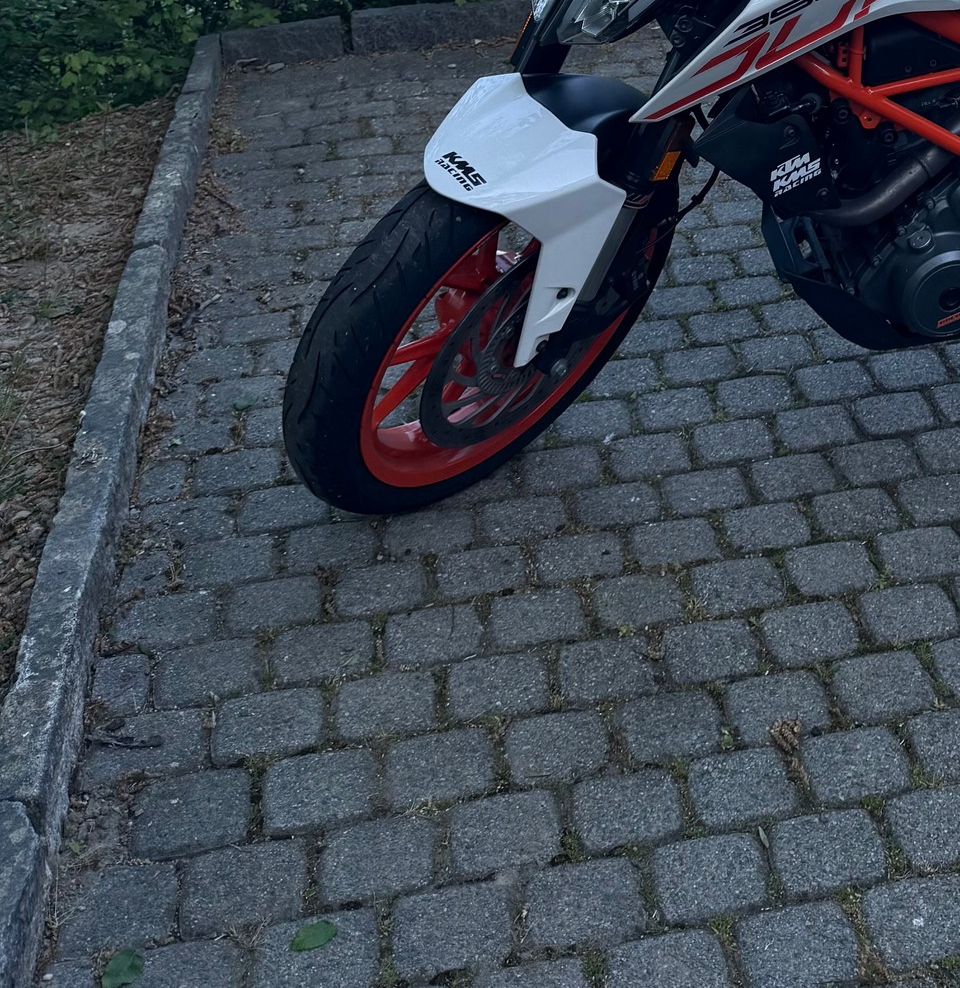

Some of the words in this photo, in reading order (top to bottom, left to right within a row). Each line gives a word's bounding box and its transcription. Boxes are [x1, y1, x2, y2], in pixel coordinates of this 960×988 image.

[442, 151, 487, 187] KMS
[770, 152, 811, 182] KTM
[773, 157, 821, 192] KMS
